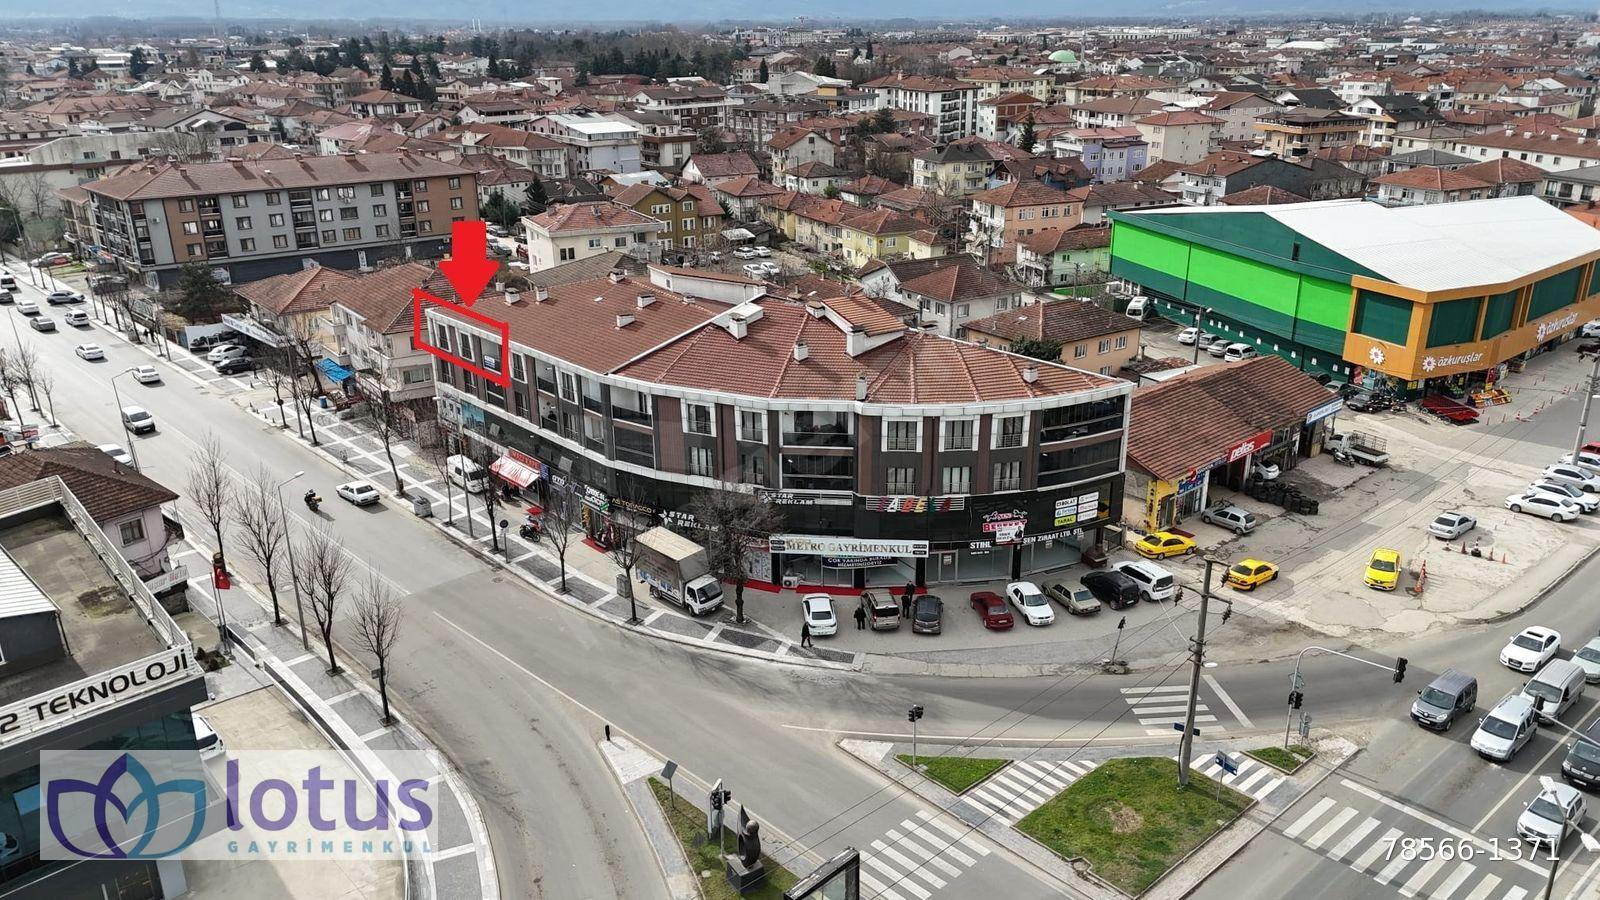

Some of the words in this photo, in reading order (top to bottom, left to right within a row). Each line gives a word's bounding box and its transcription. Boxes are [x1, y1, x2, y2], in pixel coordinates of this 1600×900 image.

[1437, 351, 1483, 367] özkuruşlar
[668, 511, 695, 520] STAR
[785, 541, 826, 552] METRO
[828, 541, 912, 554] GAYRİMENKUL
[970, 541, 991, 549] STIHL
[0, 713, 20, 734] 2
[29, 648, 189, 721] TEKNOLOJİ
